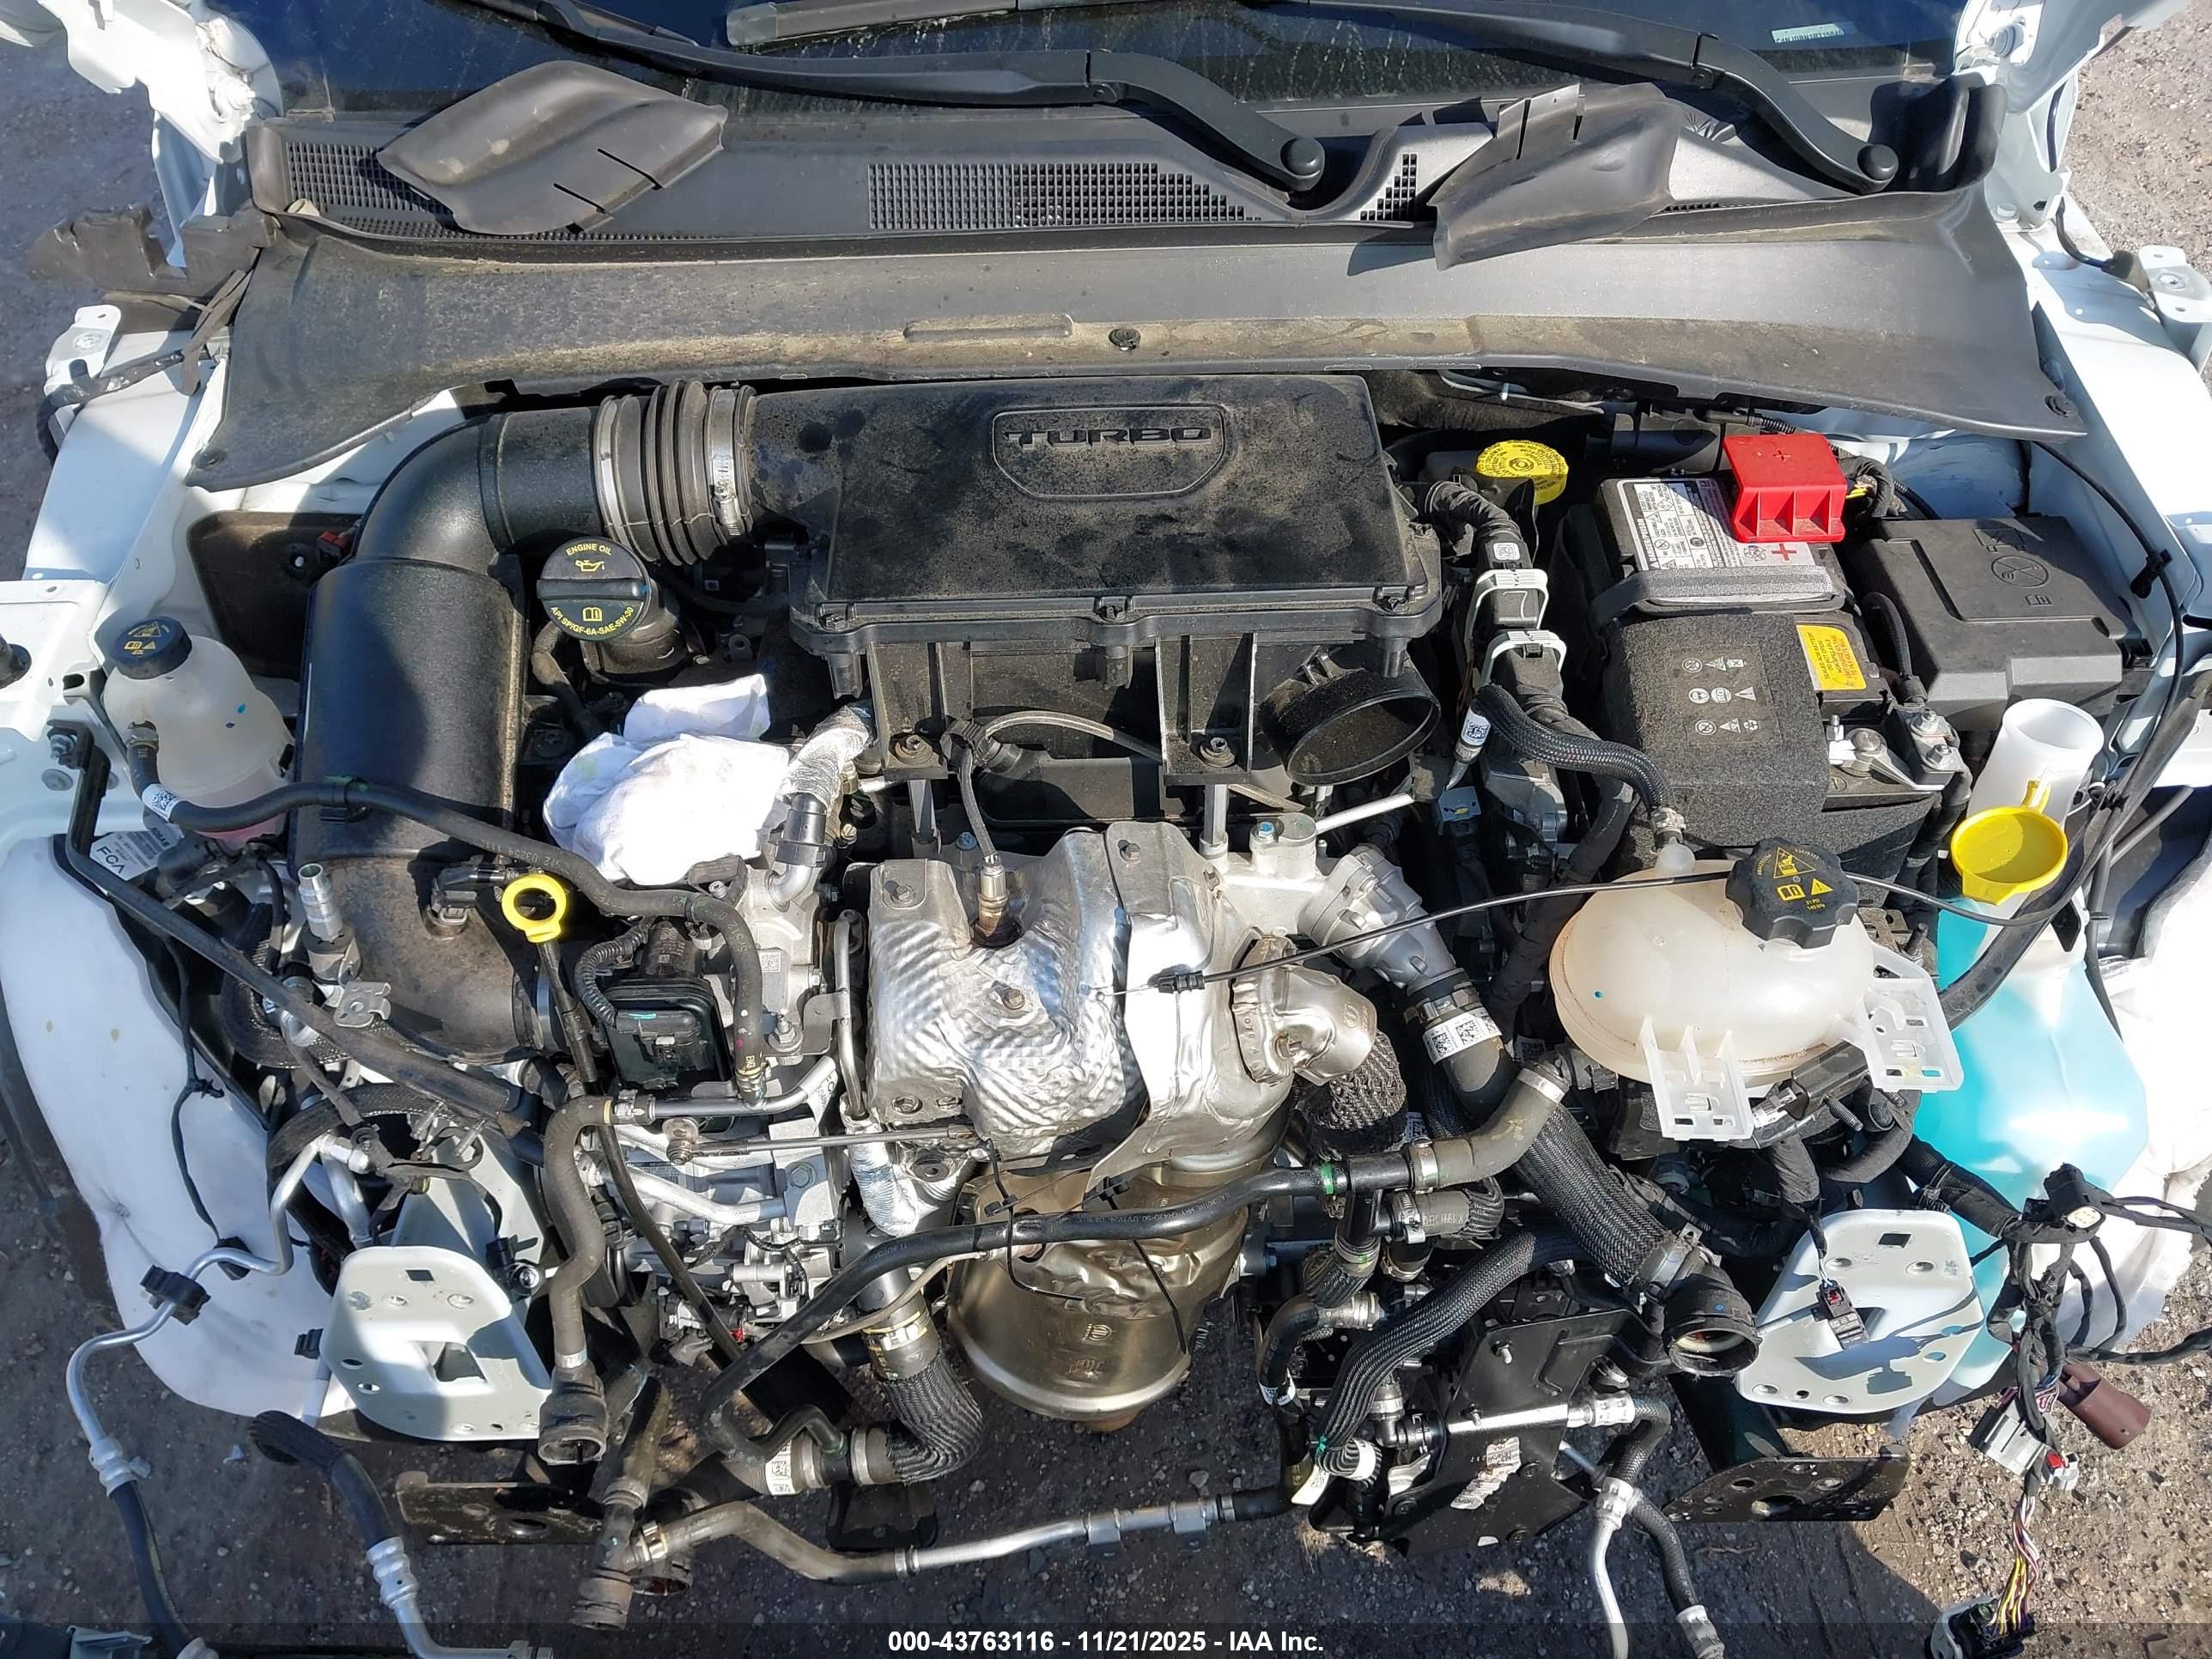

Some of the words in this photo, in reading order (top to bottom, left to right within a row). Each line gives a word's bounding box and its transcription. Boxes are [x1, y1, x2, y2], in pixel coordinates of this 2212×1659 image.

[1006, 428, 1211, 451] TURBO
[566, 543, 598, 556] ENGINE
[599, 545, 612, 556] OIL
[550, 606, 563, 620] API
